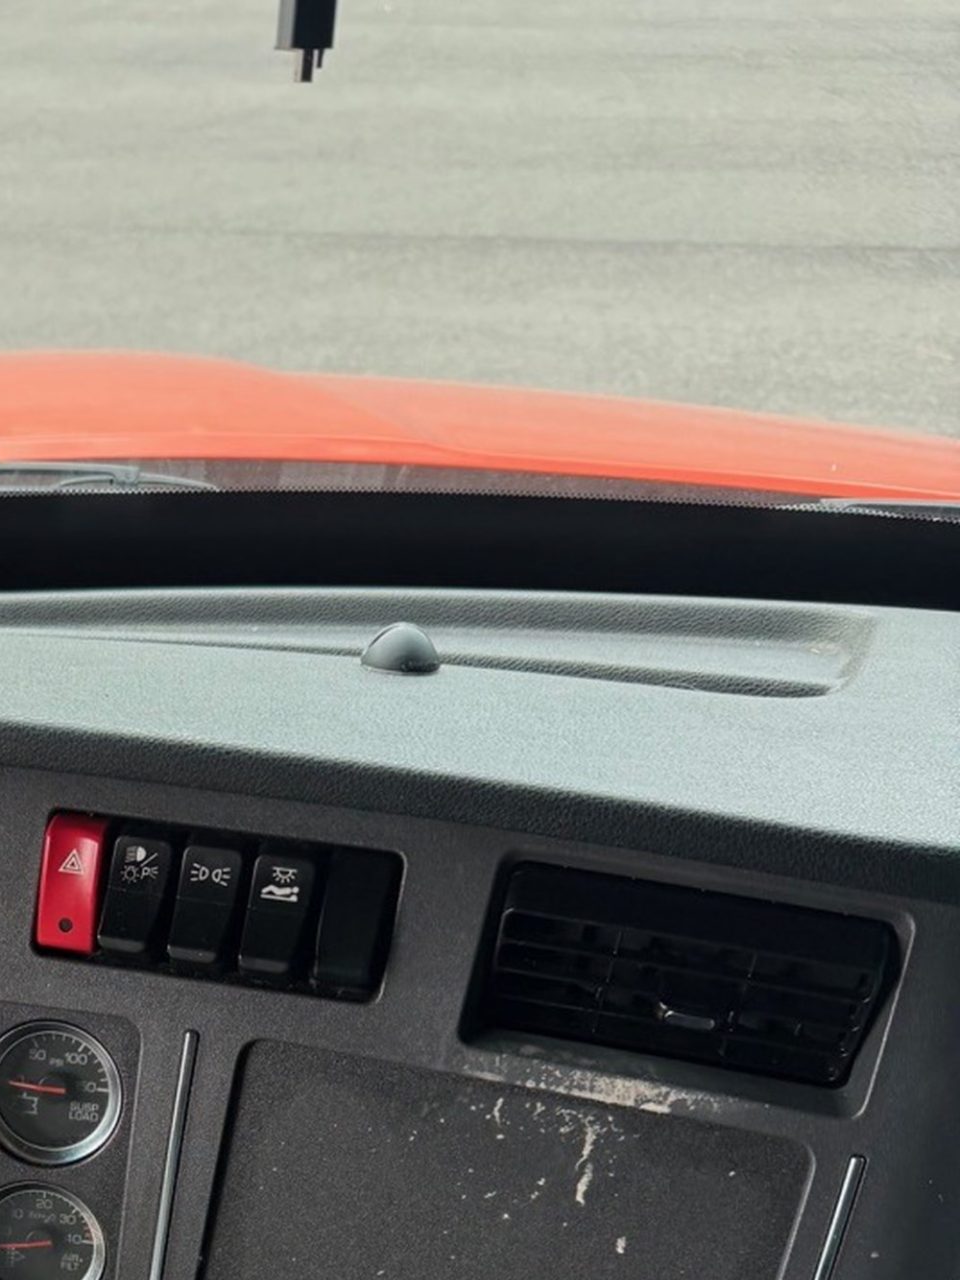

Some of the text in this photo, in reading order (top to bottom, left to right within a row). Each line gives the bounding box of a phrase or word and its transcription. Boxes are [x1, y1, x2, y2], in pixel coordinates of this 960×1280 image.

[28, 1048, 47, 1060] 50
[65, 1051, 88, 1065] 100
[68, 1109, 99, 1121] LOAD
[35, 1198, 54, 1210] 20
[60, 1213, 77, 1226] 30
